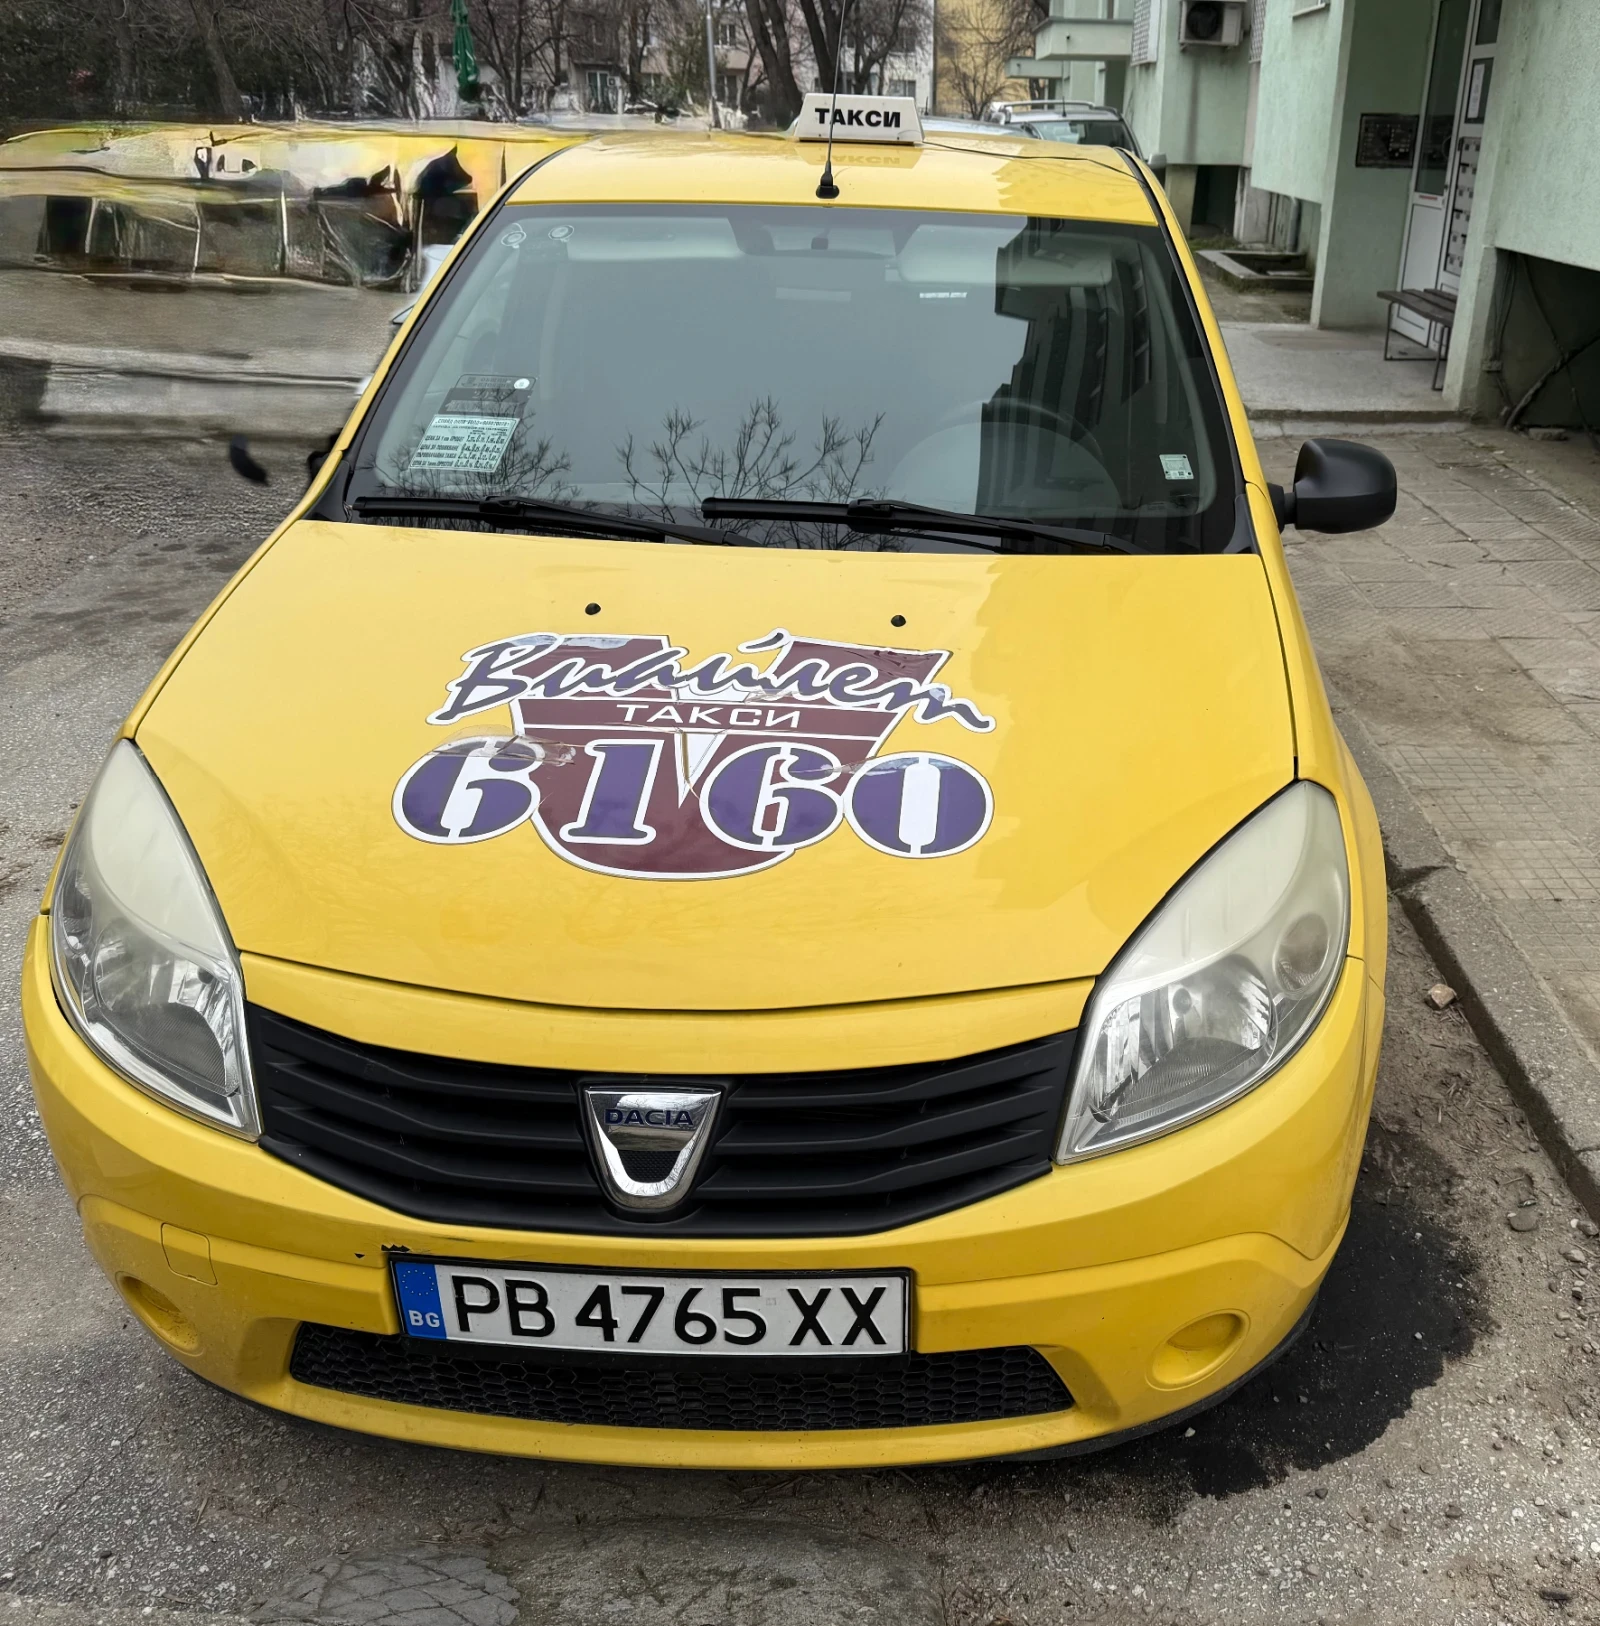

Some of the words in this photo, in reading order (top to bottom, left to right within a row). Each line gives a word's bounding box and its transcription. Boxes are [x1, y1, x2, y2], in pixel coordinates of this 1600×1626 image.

[814, 107, 901, 128] ТАКСИ
[615, 703, 801, 729] ТАКСИ
[396, 735, 991, 857] 6160
[604, 1108, 694, 1126] DACIA
[408, 1310, 441, 1329] BG
[450, 1274, 558, 1338] PB
[573, 1284, 768, 1346] 4765
[785, 1286, 888, 1347] XX
